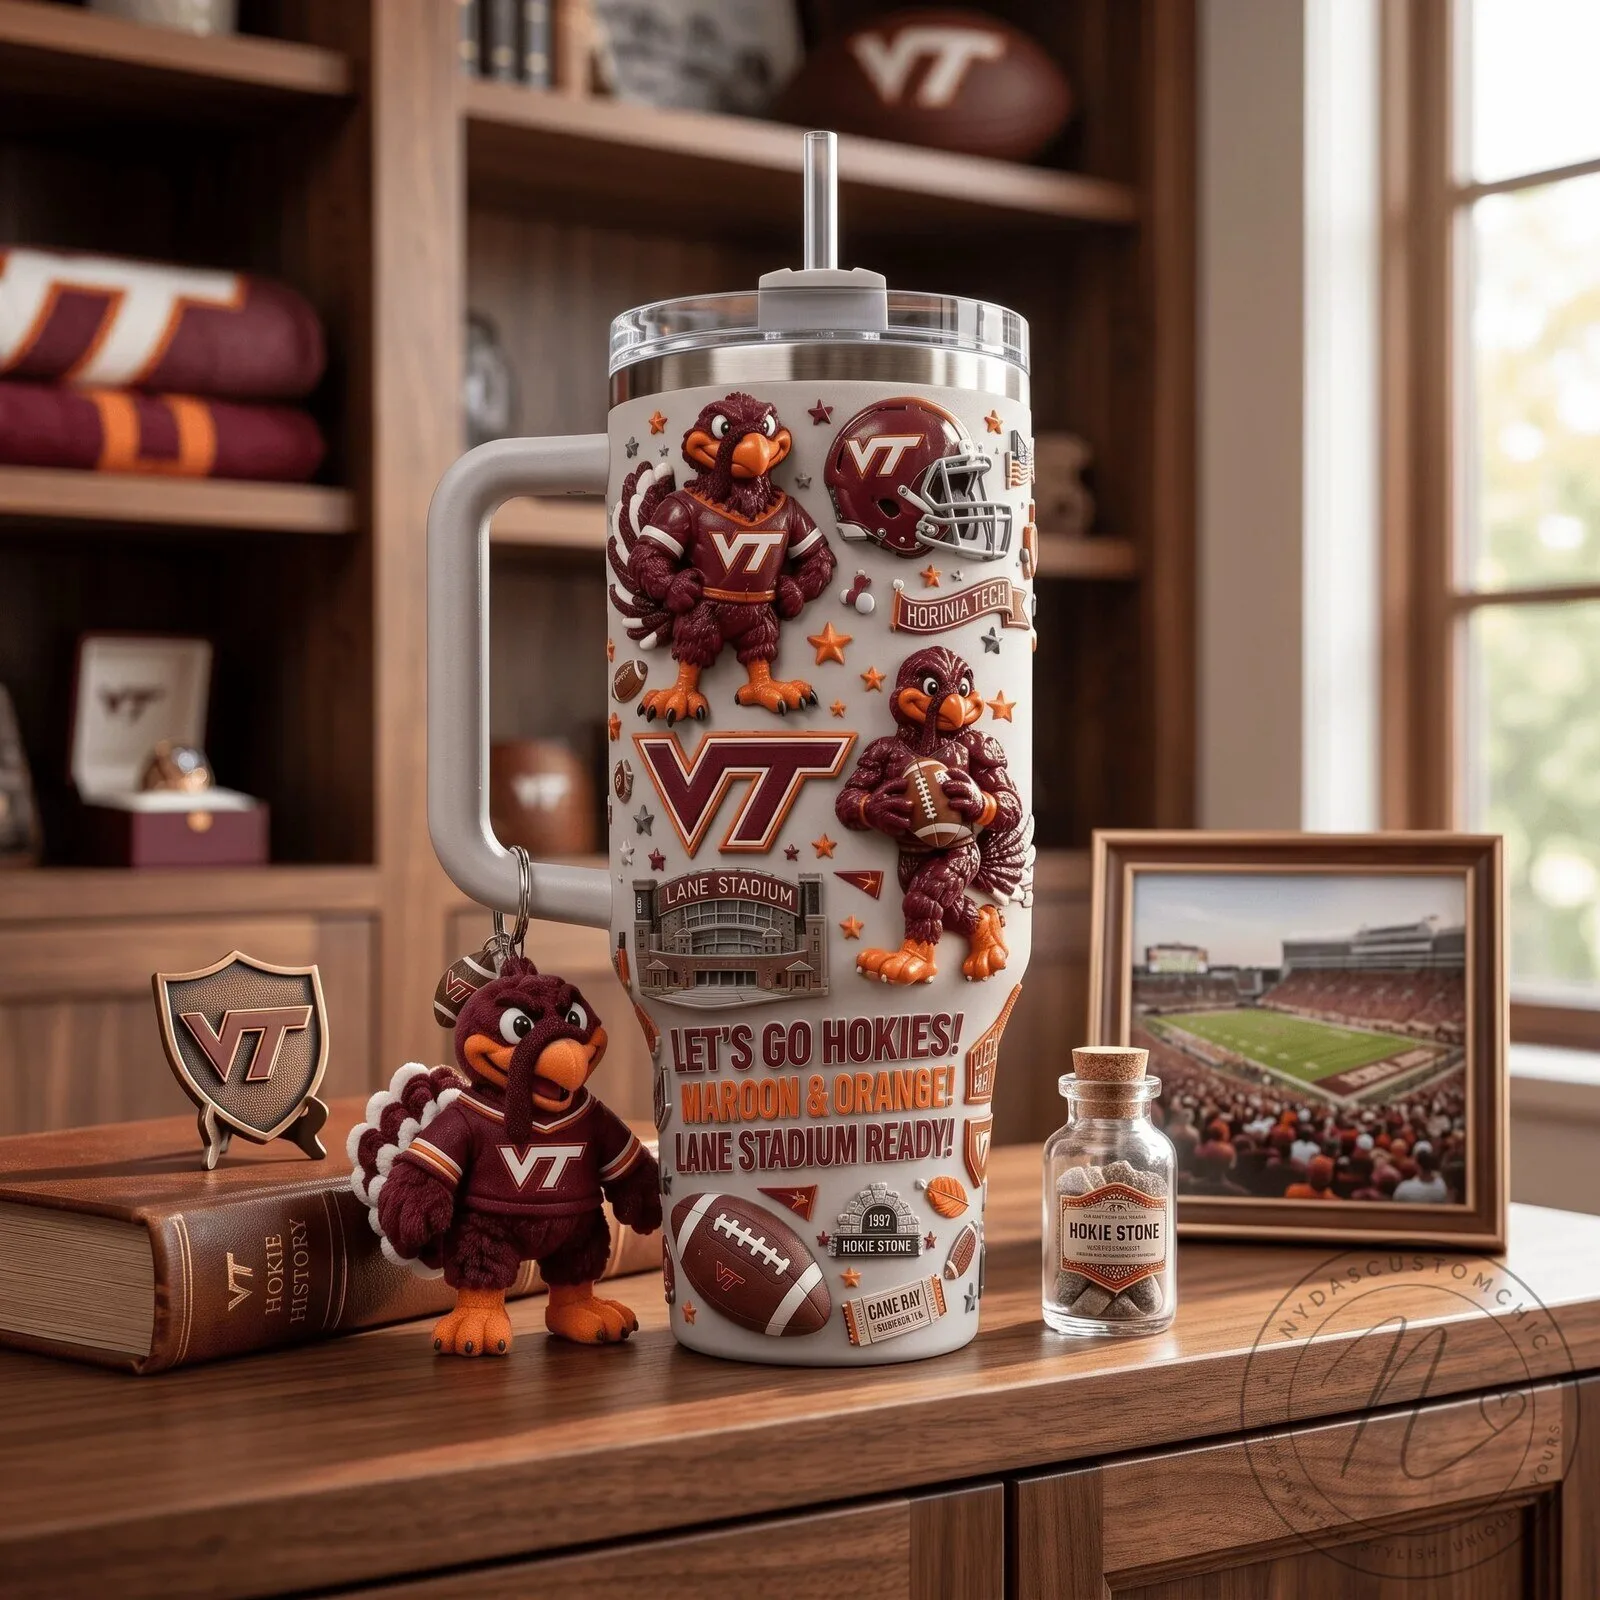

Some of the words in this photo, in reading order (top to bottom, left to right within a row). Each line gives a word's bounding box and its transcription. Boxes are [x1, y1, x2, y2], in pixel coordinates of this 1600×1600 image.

[851, 26, 1004, 107] VT
[845, 434, 925, 479] VT
[708, 530, 788, 575] VT
[907, 598, 970, 627] HORINIA
[972, 584, 1006, 612] TECH
[632, 731, 858, 860] VT
[666, 877, 709, 905] LANE
[718, 876, 793, 906] STADIUM
[179, 1004, 313, 1083] VT
[670, 1024, 754, 1073] LET'S
[762, 1020, 813, 1069] GO
[822, 1012, 964, 1065] HOKIES!
[680, 1076, 800, 1124] MAROON
[806, 1074, 829, 1118] &
[833, 1065, 956, 1114] ORANGE!
[495, 1142, 587, 1192] VT
[674, 1129, 733, 1174] LANE
[738, 1122, 858, 1173] STADIUM
[863, 1117, 956, 1165] READY!
[842, 1239, 875, 1253] HOKIE
[876, 1238, 912, 1252] STONE
[868, 1213, 891, 1228] 1997
[1069, 1221, 1112, 1241] HOKIE
[1116, 1222, 1160, 1242] STONE
[226, 1251, 254, 1312] VT
[265, 1233, 284, 1315] HOKIE
[289, 1218, 309, 1324] HISTORY
[715, 1260, 746, 1291] VT
[867, 1296, 901, 1321] CANE
[900, 1288, 922, 1311] BAY
